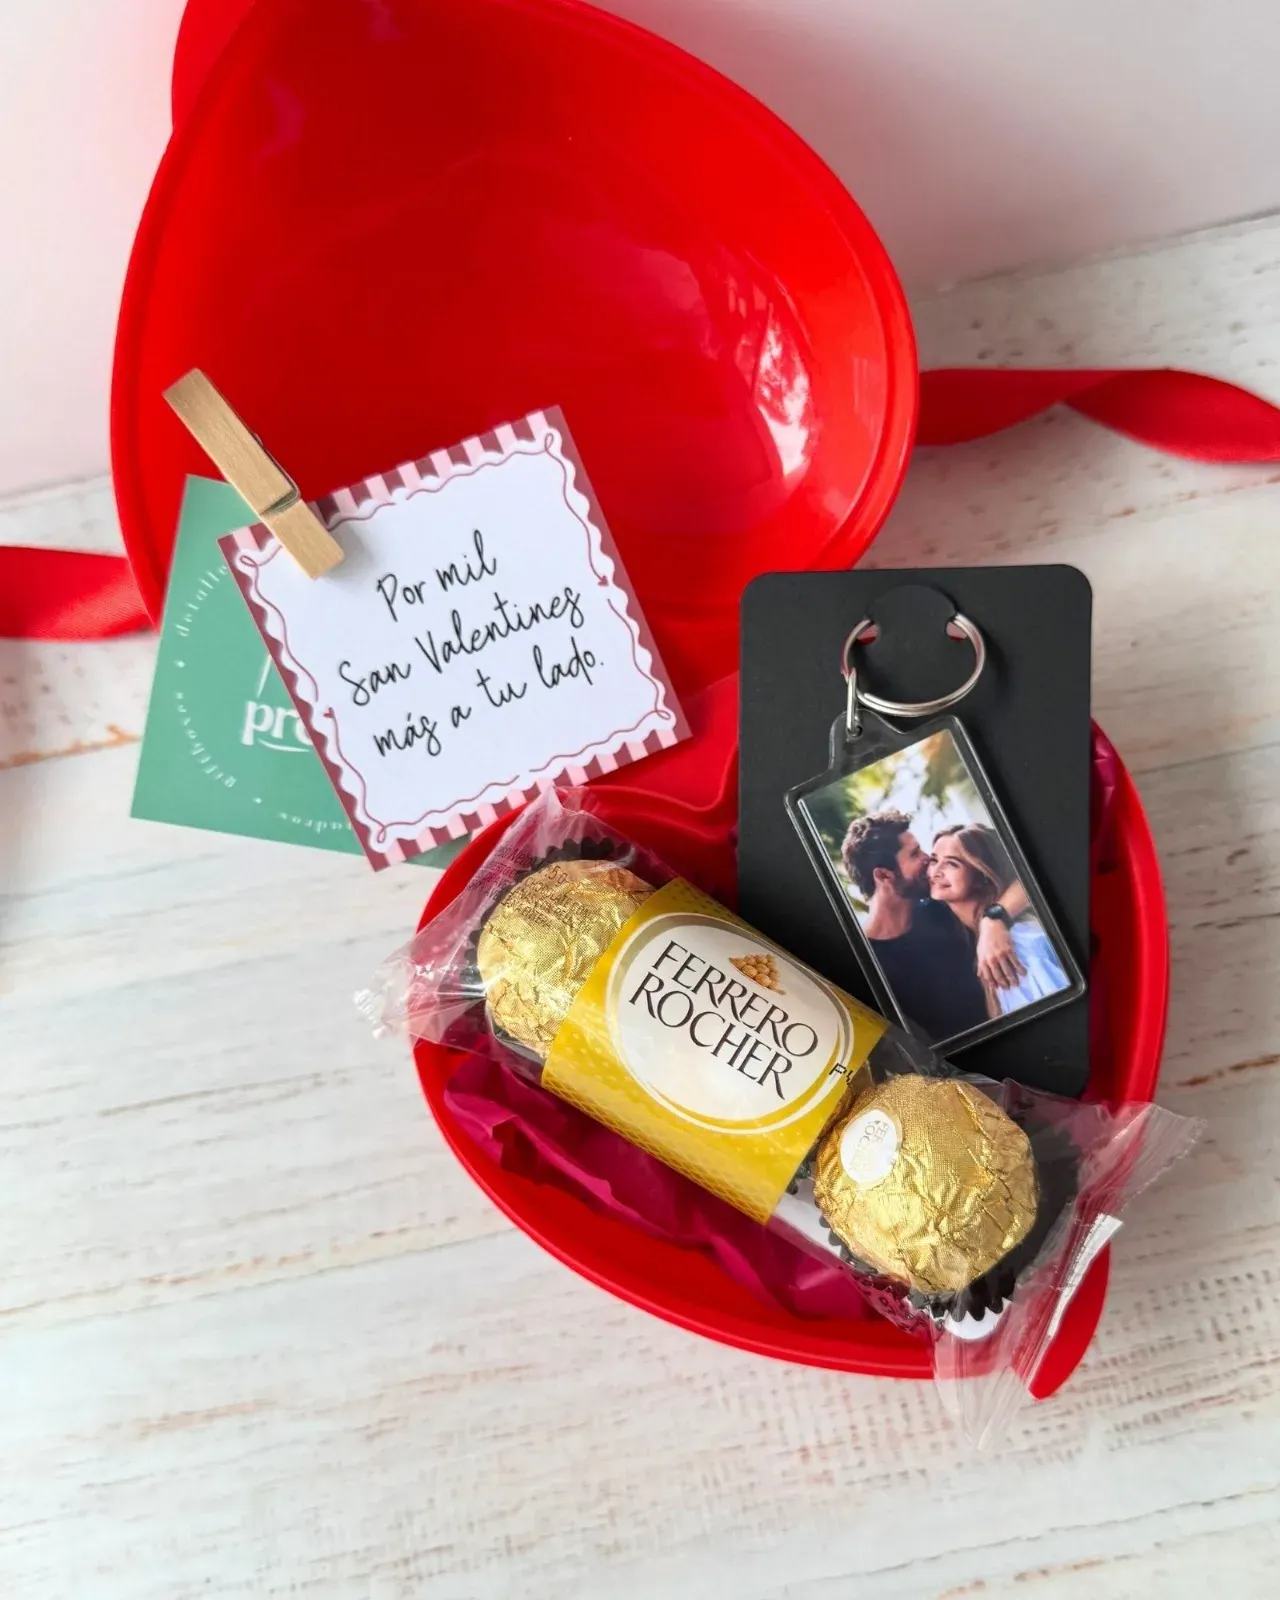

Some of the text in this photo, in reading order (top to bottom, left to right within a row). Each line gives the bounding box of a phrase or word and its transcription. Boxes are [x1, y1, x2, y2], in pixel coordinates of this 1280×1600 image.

[376, 529, 497, 622] Por mil
[339, 587, 584, 706] San Valentines
[373, 636, 604, 757] más a tu lado.
[629, 971, 793, 1100] ROCHER
[652, 940, 818, 1057] FERRERO
